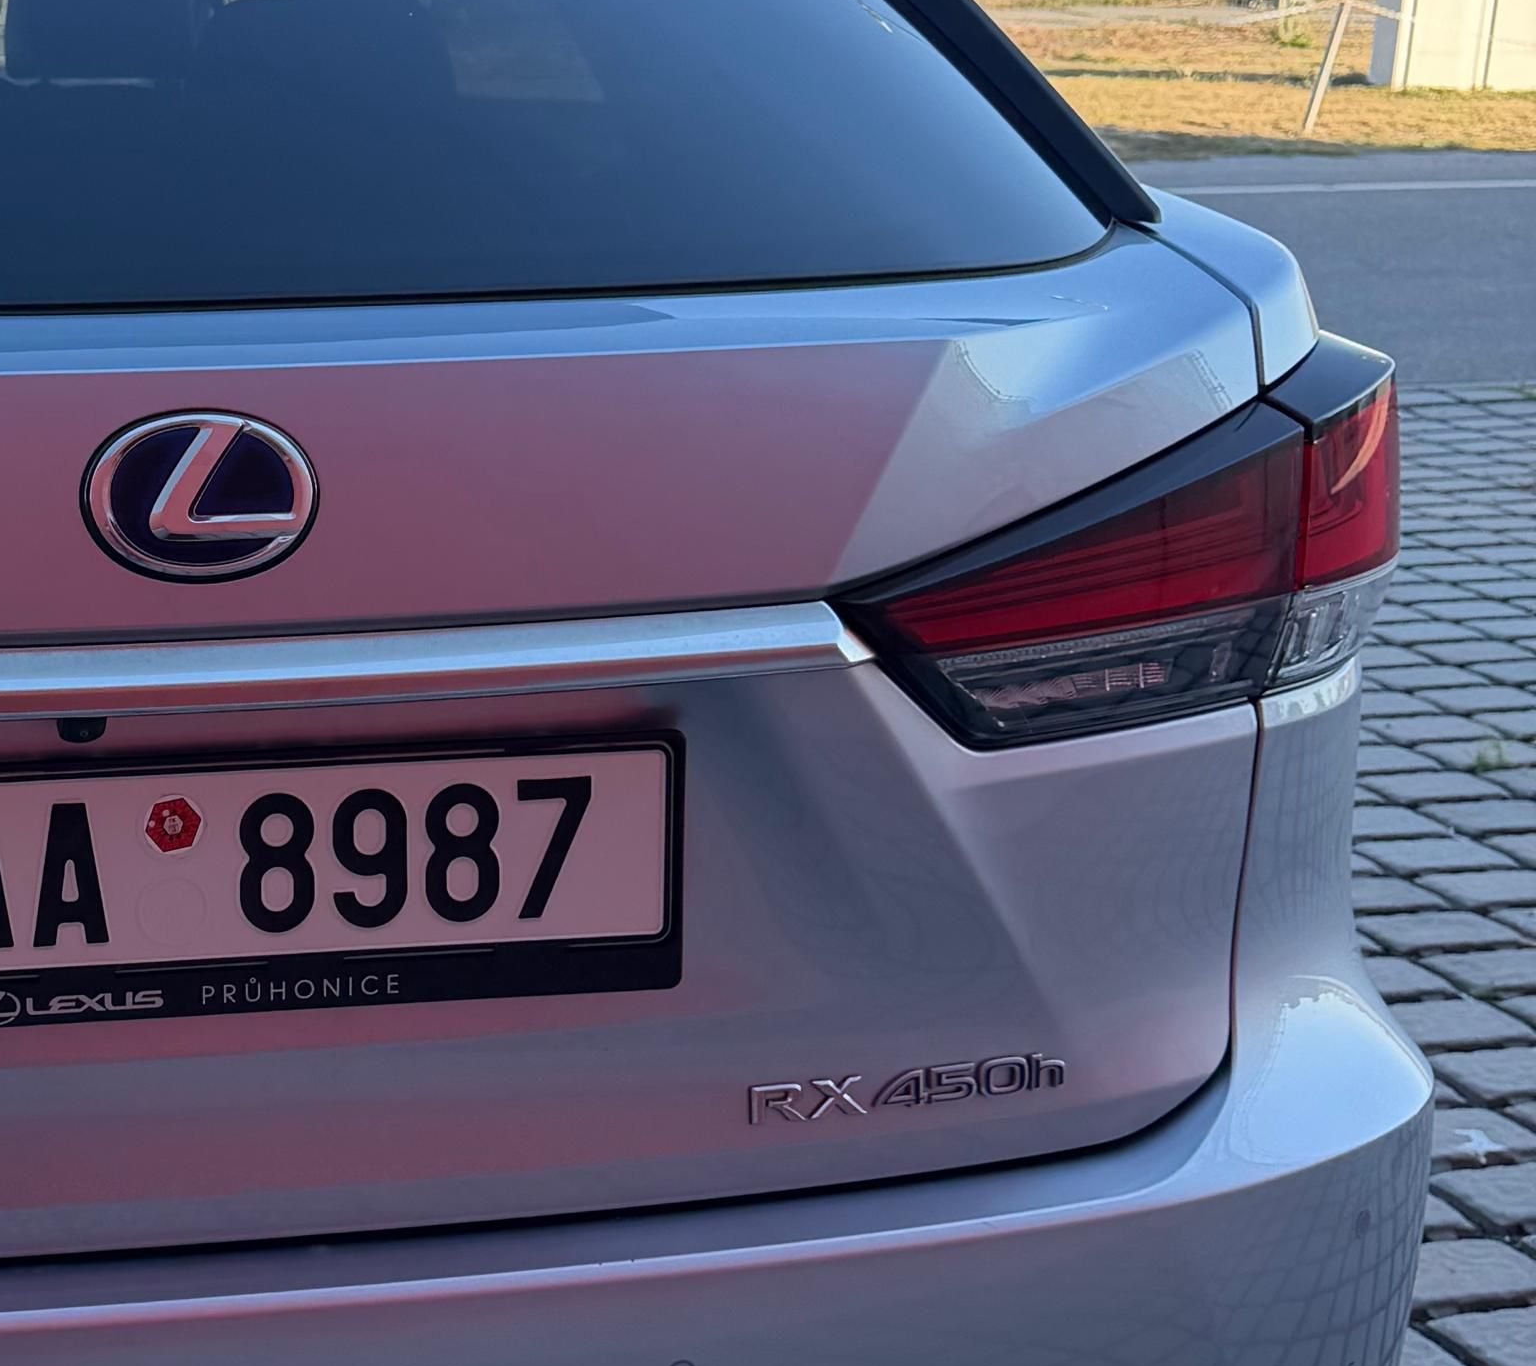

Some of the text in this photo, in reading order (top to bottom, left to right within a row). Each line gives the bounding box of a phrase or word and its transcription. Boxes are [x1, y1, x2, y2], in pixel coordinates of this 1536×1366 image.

[239, 775, 592, 933] 8987
[26, 989, 164, 1016] LEXUS
[202, 974, 400, 1005] PRŮHONICE
[748, 1052, 1066, 1126] RX 450h
